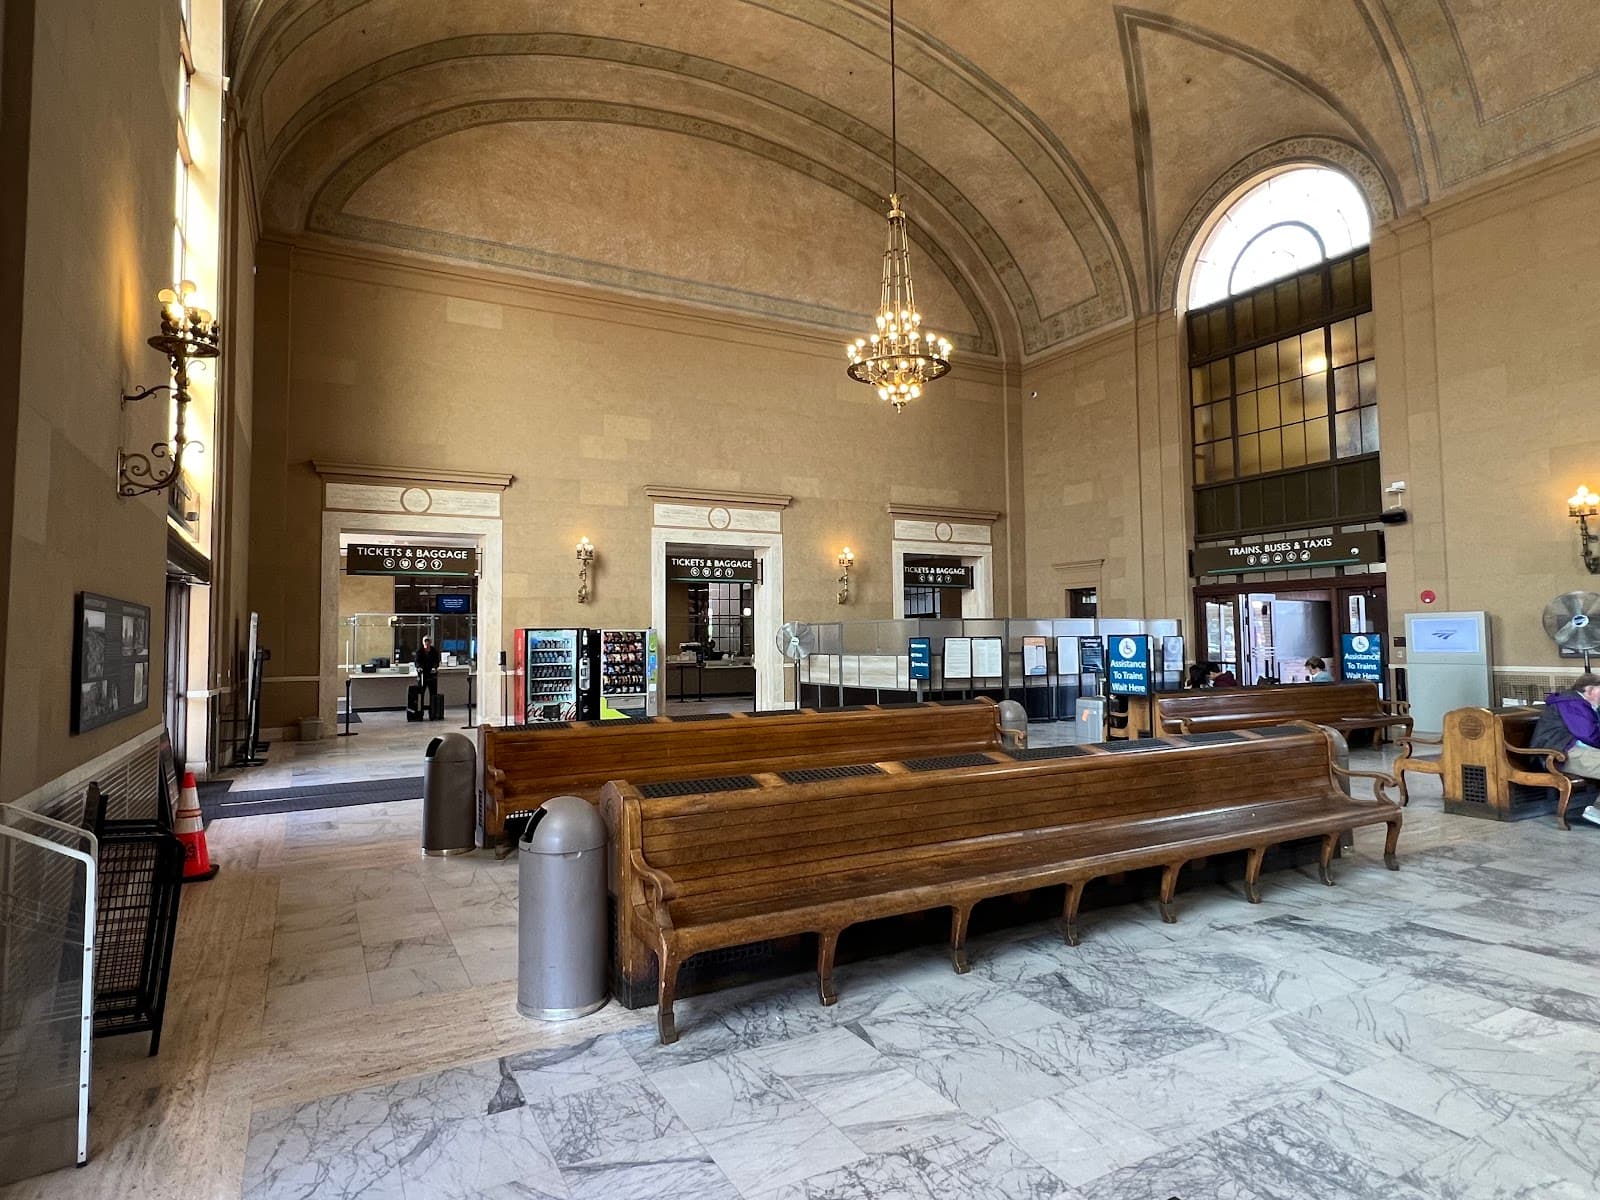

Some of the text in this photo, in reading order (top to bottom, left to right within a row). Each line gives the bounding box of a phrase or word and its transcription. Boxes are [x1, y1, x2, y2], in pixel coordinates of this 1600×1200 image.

[1228, 538, 1333, 556] TRAINS, BUSES & TAXIS
[356, 546, 468, 559] TICKETS & BAGGAGE
[671, 558, 752, 569] TICKETS & BAGGAGE
[936, 567, 966, 575] BAGGAGE
[1344, 653, 1380, 661] Assistance
[1110, 659, 1146, 669] Assistance
[1346, 662, 1377, 670] To Trains
[1113, 671, 1144, 680] To Trains
[1346, 671, 1380, 680] Wait Here
[1111, 682, 1146, 692] Wait Here
